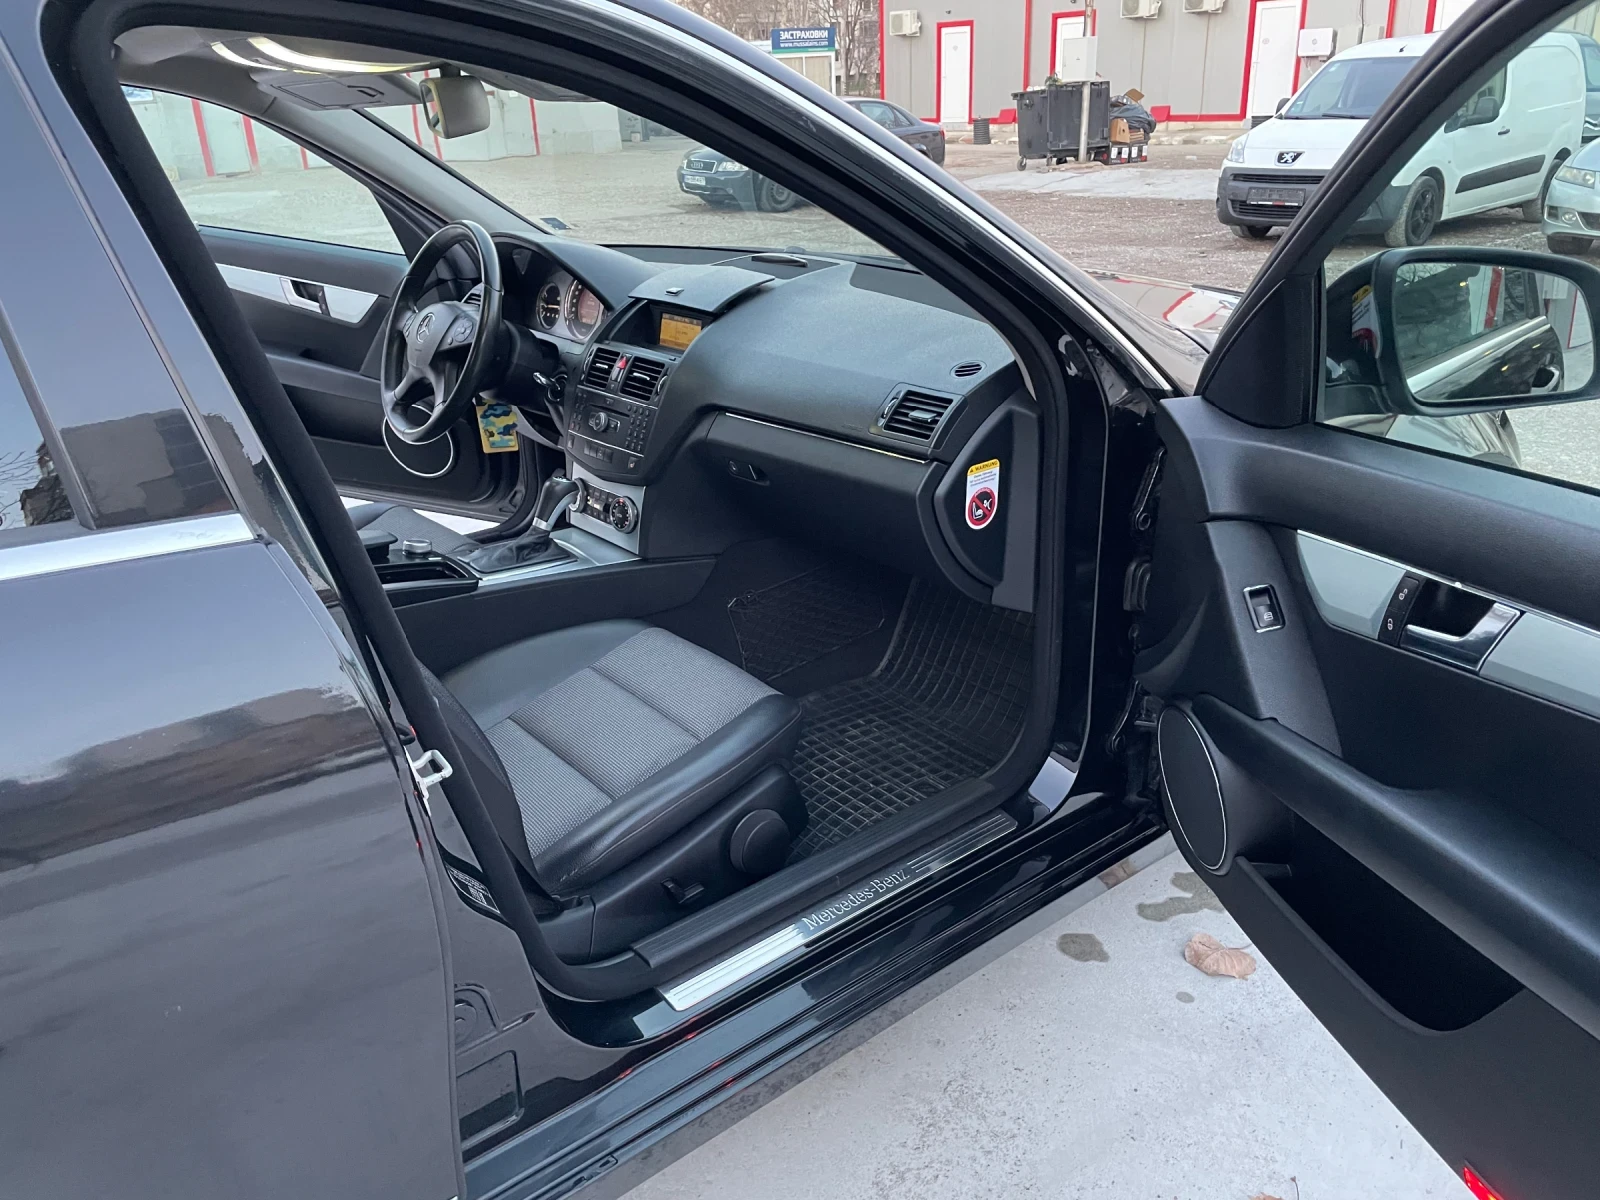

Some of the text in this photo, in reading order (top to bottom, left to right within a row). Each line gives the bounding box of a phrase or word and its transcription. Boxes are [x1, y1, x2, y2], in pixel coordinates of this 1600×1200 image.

[780, 30, 828, 39] ЗАСТРАХОВКИ
[975, 461, 998, 471] WARNING
[802, 869, 910, 931] Mercedes-Benz
